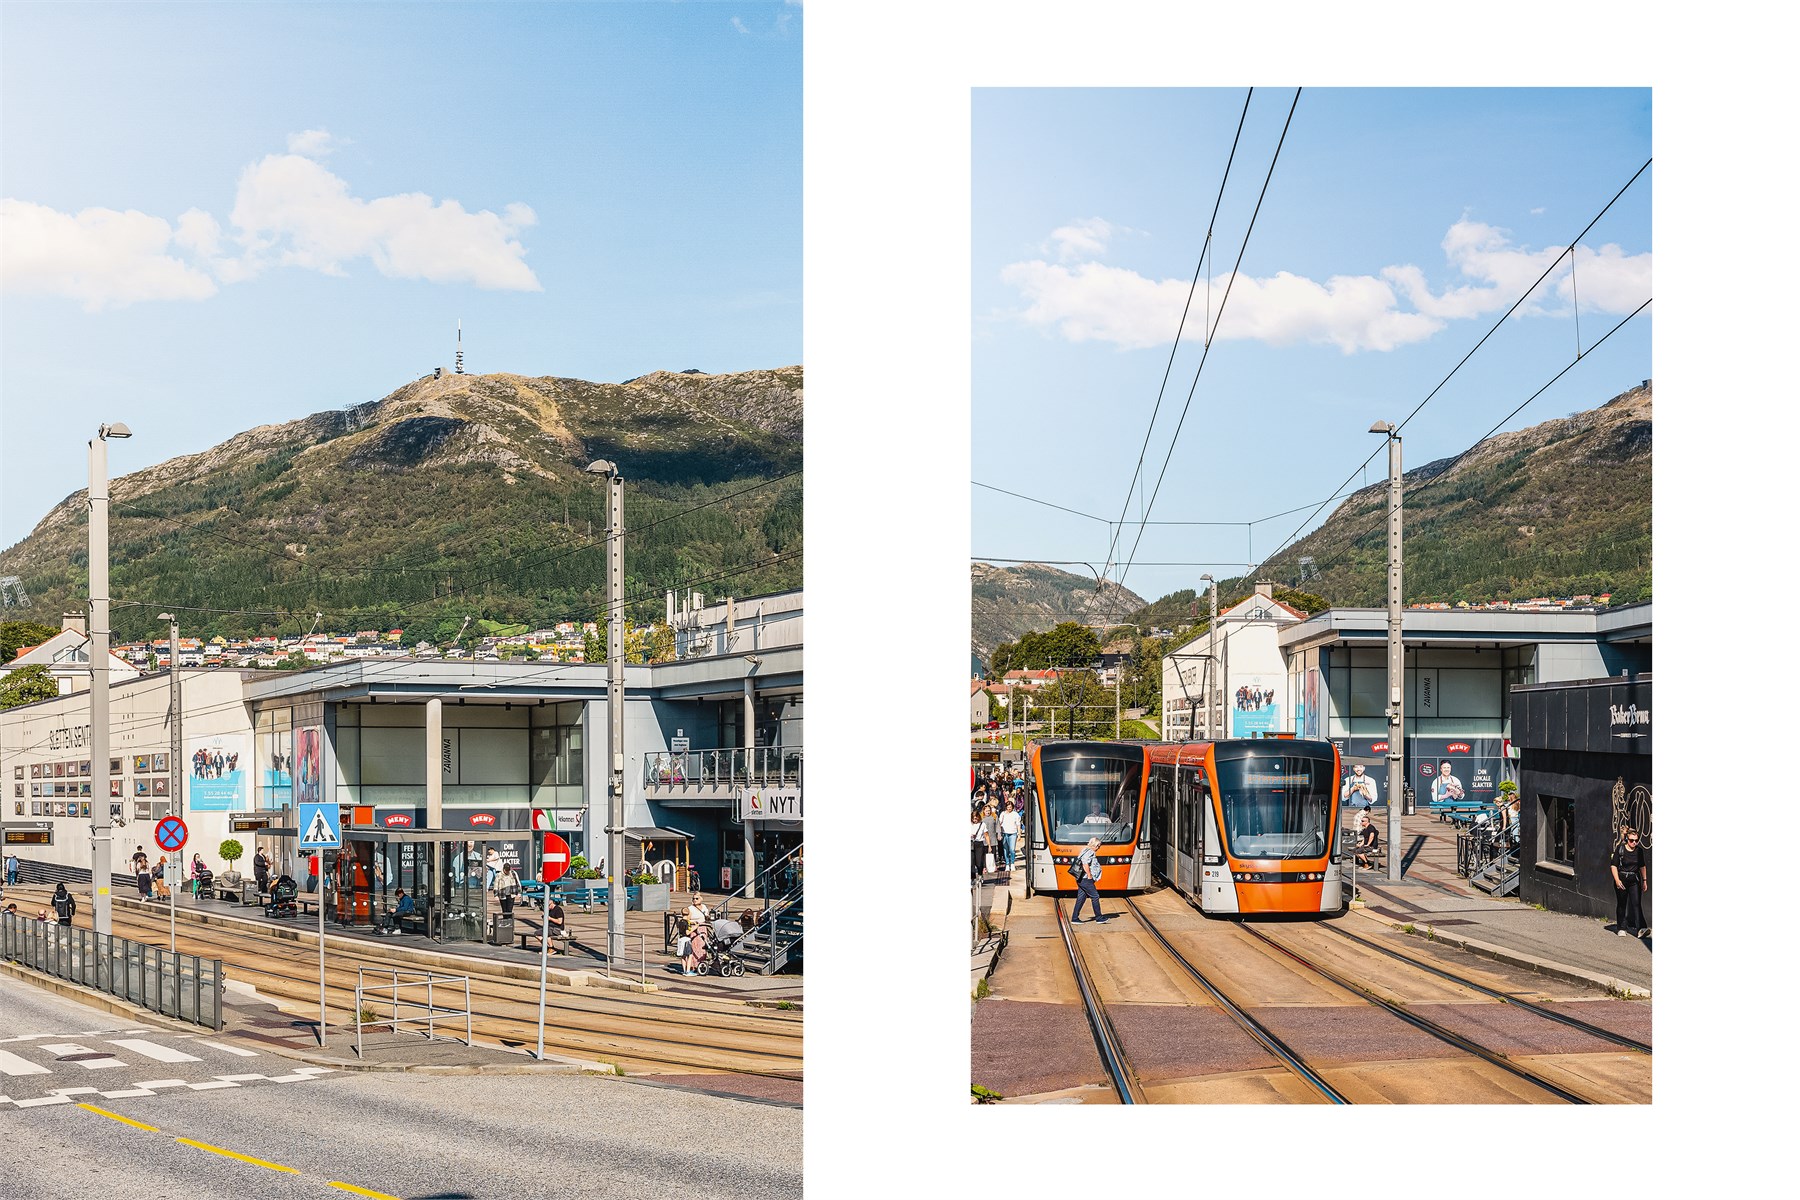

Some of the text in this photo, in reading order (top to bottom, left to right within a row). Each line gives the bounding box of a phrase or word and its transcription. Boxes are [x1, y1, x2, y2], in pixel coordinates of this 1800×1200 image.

[1423, 677, 1431, 708] ZAVANNA
[50, 725, 91, 750] SLETTEN SENT
[443, 738, 451, 774] ZAVANNA
[770, 796, 796, 814] NYT
[387, 816, 410, 824] MENY
[472, 815, 493, 824] MENY
[500, 850, 519, 858] LOKALE
